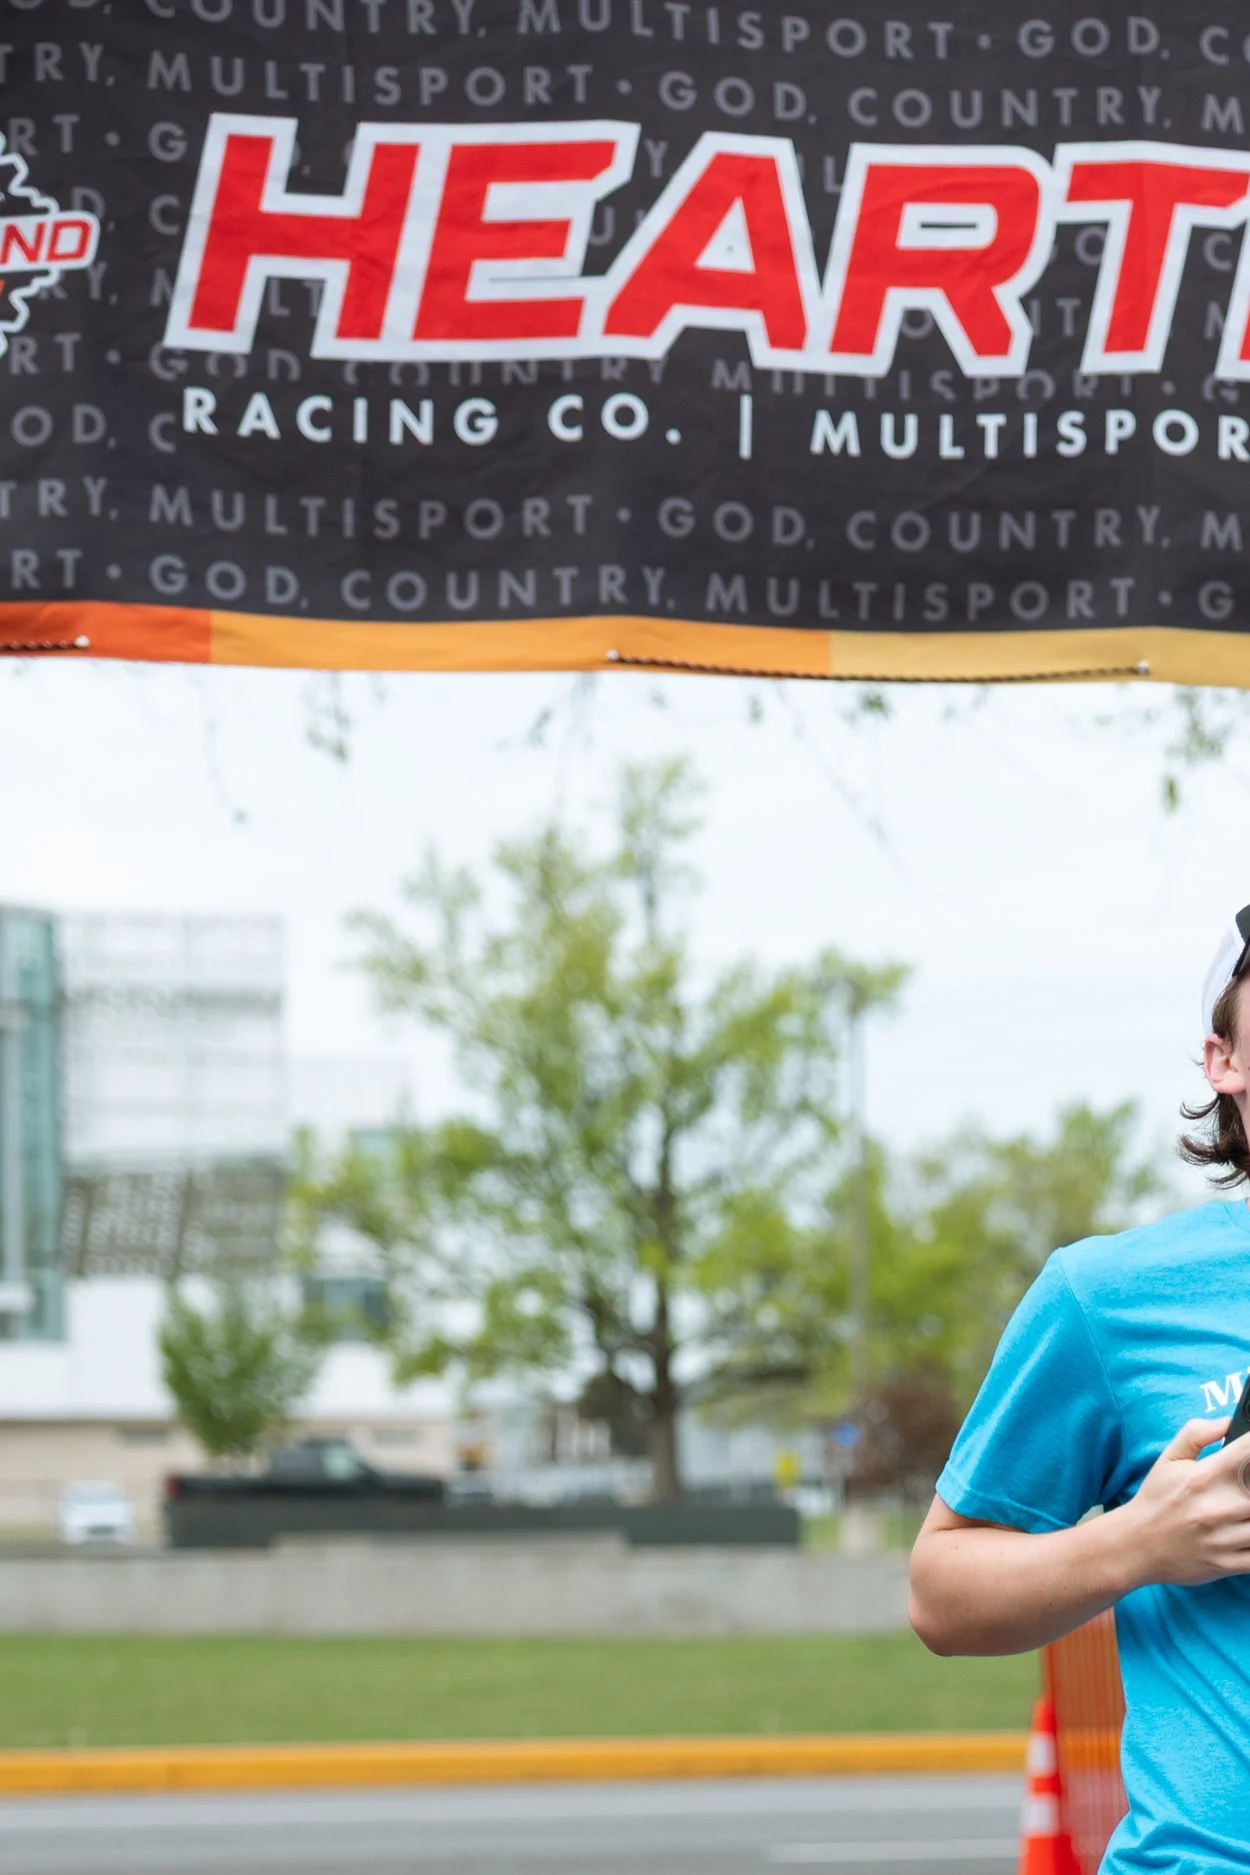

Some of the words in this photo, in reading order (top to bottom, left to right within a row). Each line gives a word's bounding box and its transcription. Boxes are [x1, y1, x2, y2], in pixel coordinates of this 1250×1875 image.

[517, 0, 955, 60] MULTISPORT
[147, 50, 593, 106] MULTISPORT
[183, 386, 500, 445] RACING
[546, 393, 682, 445] CO.
[149, 484, 593, 539] MULTISPORT
[704, 571, 1136, 621] MULTISPORT
